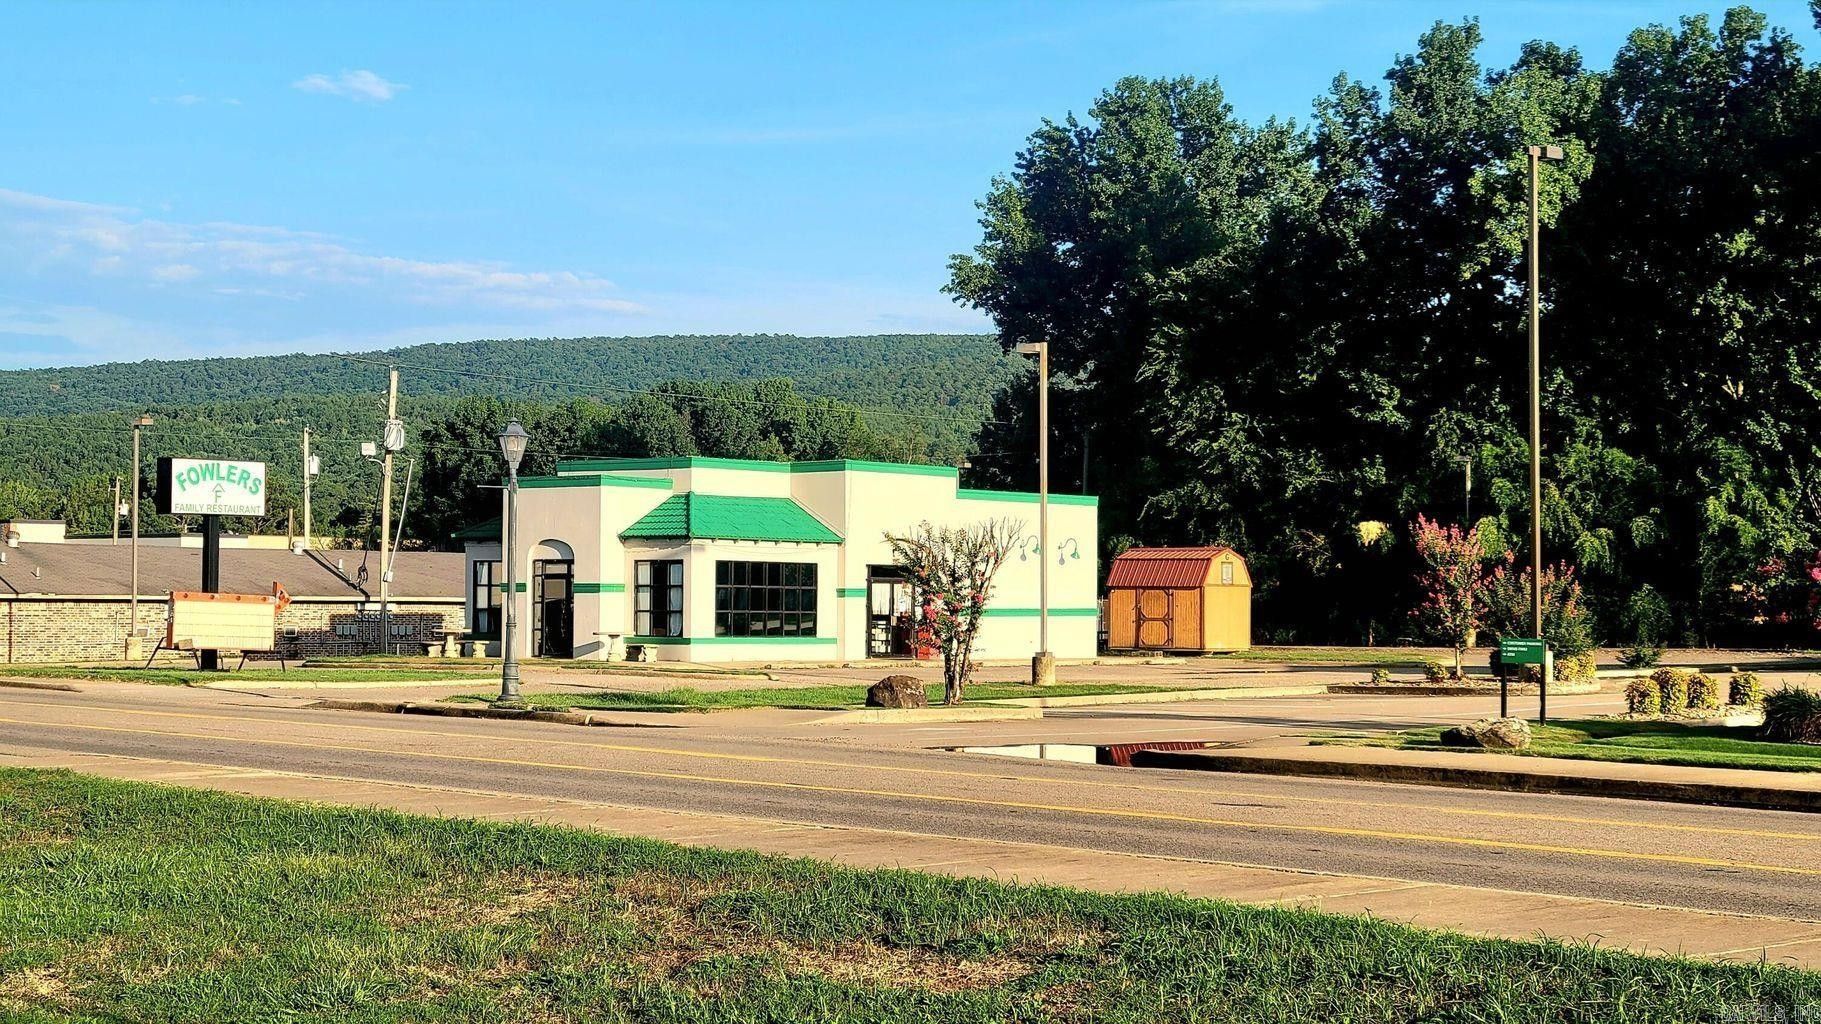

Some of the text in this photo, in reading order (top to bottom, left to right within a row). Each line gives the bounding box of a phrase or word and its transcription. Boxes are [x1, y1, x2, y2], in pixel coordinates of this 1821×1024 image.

[175, 462, 263, 495] FOWLERS
[214, 490, 222, 503] F
[174, 503, 261, 514] FAMILY RESTAURANT
